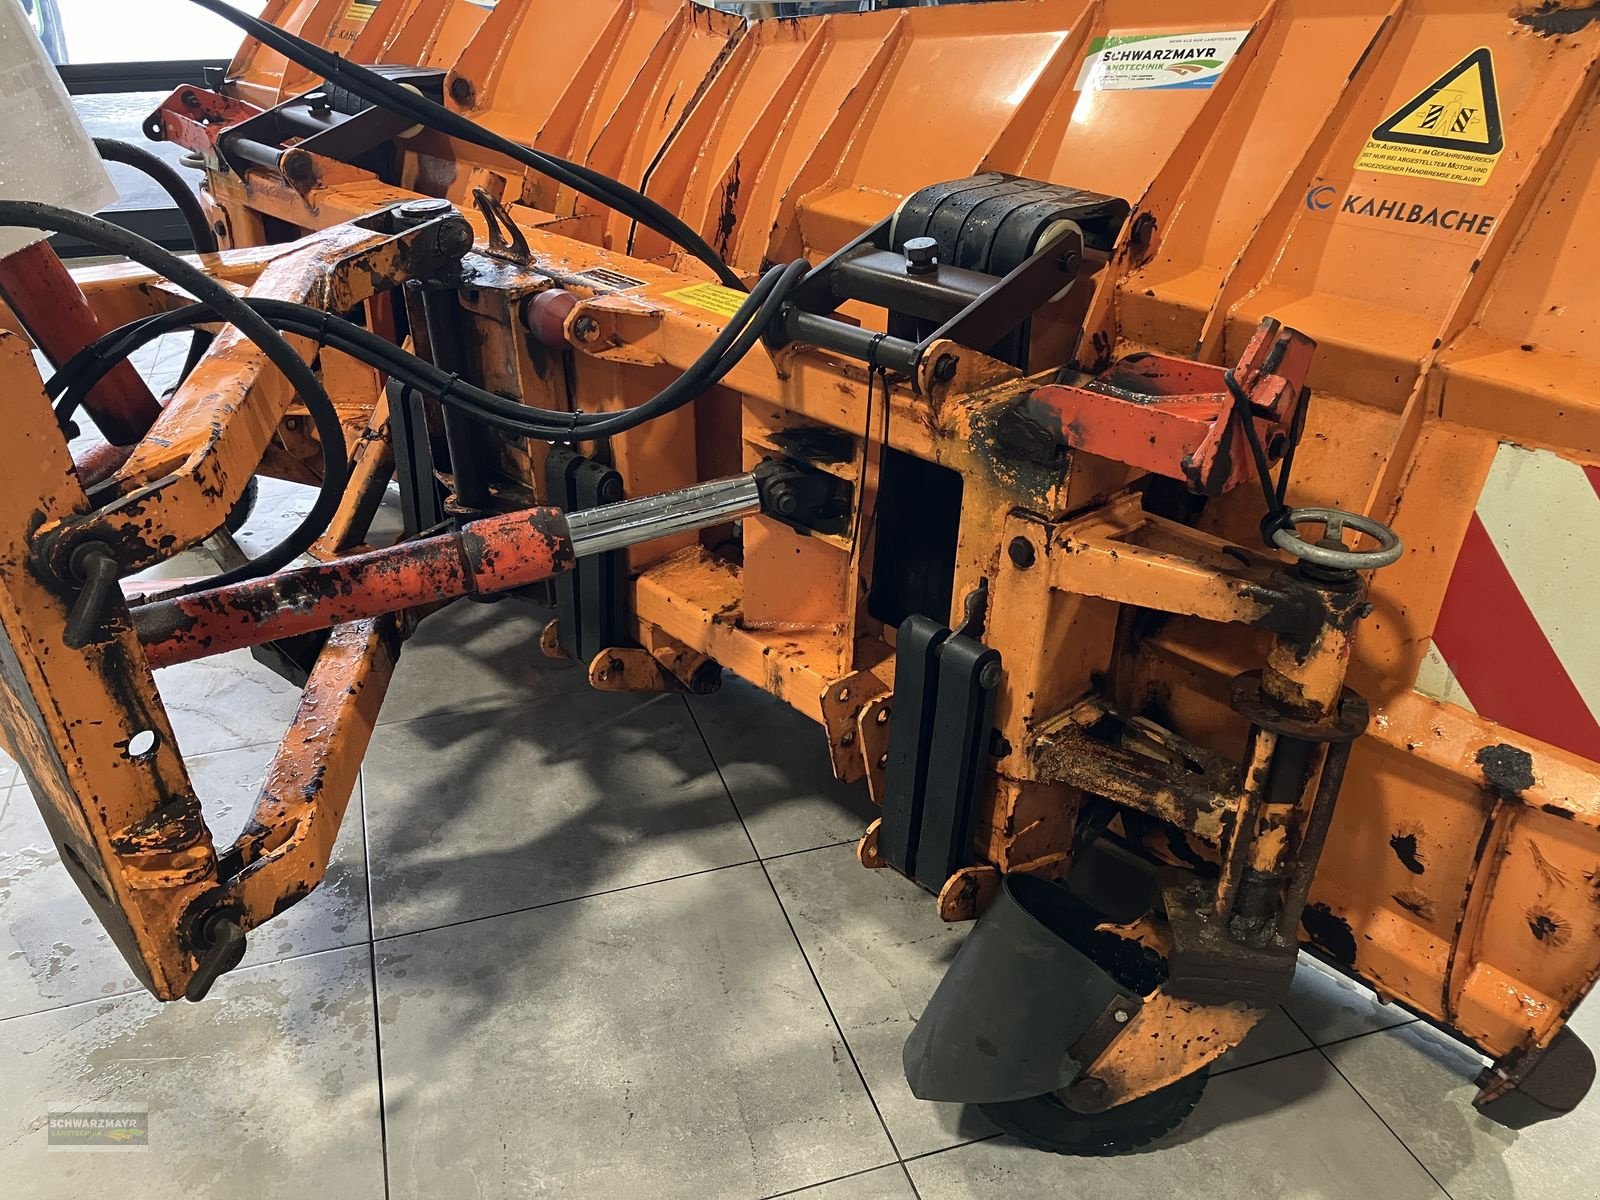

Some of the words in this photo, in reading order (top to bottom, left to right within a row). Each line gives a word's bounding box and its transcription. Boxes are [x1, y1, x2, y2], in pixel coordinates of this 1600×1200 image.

[1103, 48, 1216, 62] SCHWARZMAYR
[1104, 63, 1165, 72] ANDTECHNIK
[1381, 143, 1422, 154] AUFENTHALT
[1430, 150, 1496, 164] GEFAHRENBEREICH
[1359, 162, 1404, 172] ANGEZOGENER
[1405, 167, 1450, 179] HANDBREMSE
[1450, 174, 1482, 183] ERLAUBT
[1397, 157, 1449, 168] ABGESTELLTEM
[1448, 163, 1473, 172] MOTOR
[1341, 194, 1494, 236] KAHLBACHE
